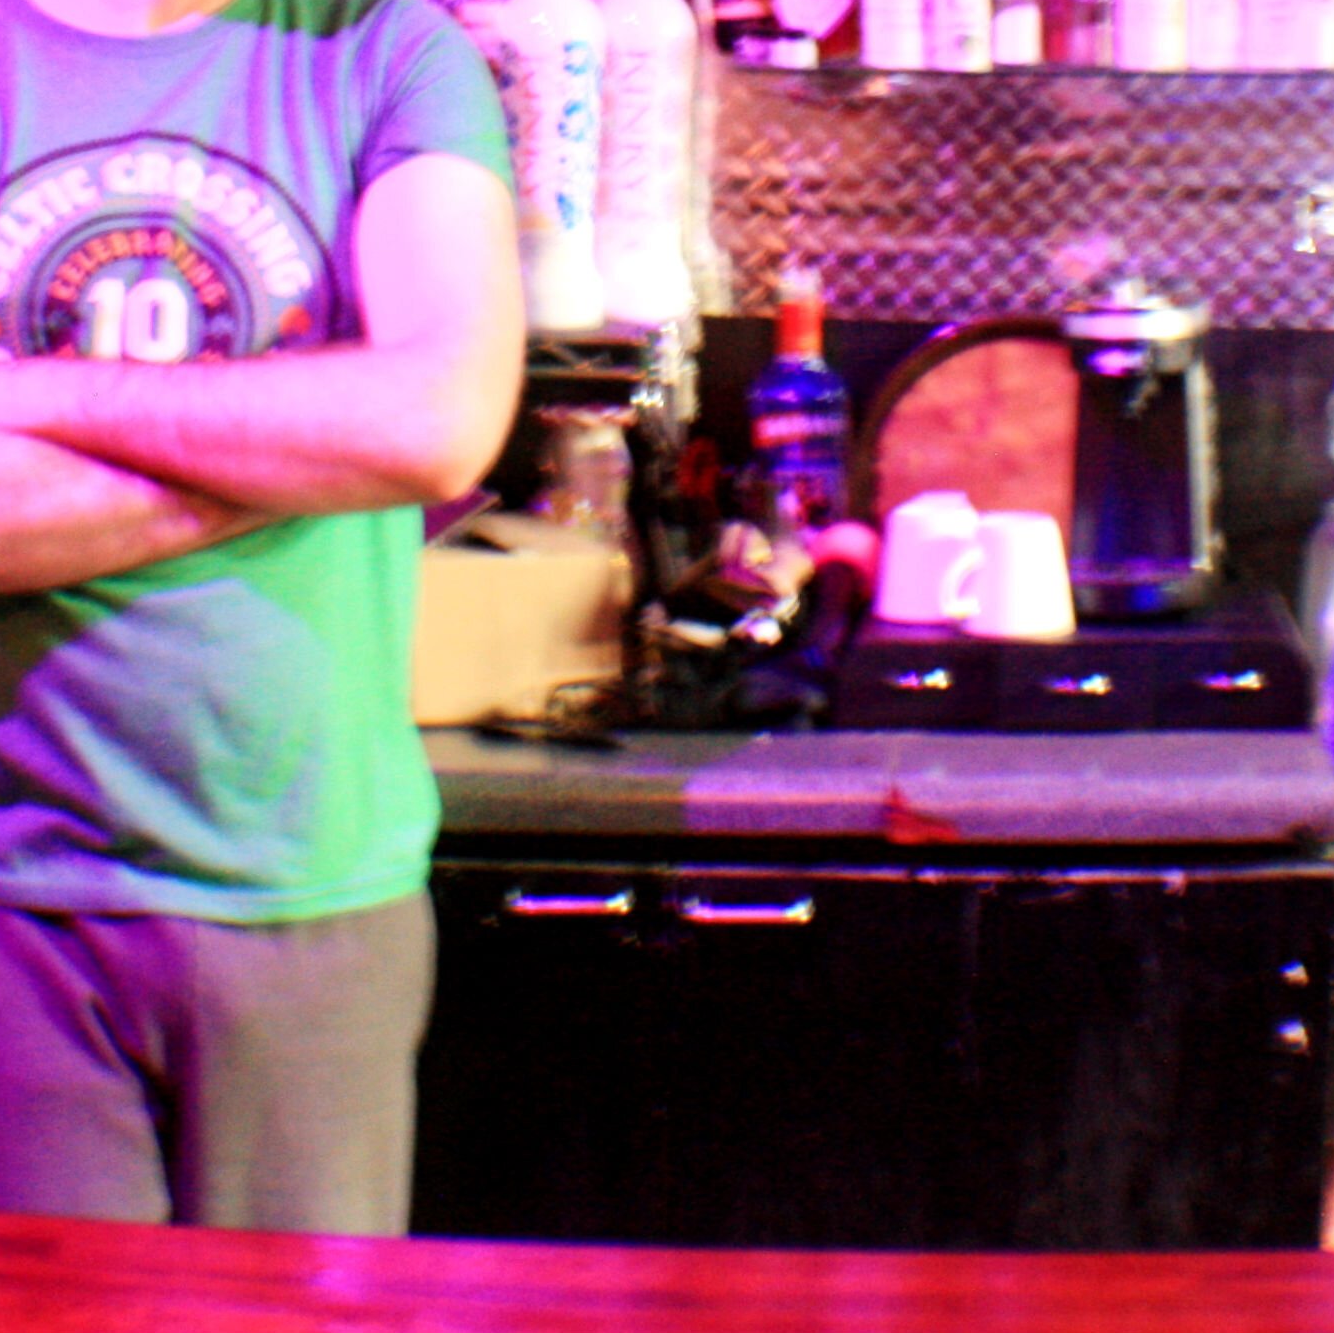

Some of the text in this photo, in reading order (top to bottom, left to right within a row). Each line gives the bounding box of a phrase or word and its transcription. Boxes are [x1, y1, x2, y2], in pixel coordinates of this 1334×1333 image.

[48, 229, 228, 307] CELEBRATING
[100, 153, 312, 298] CROSSING
[86, 277, 189, 363] 10
